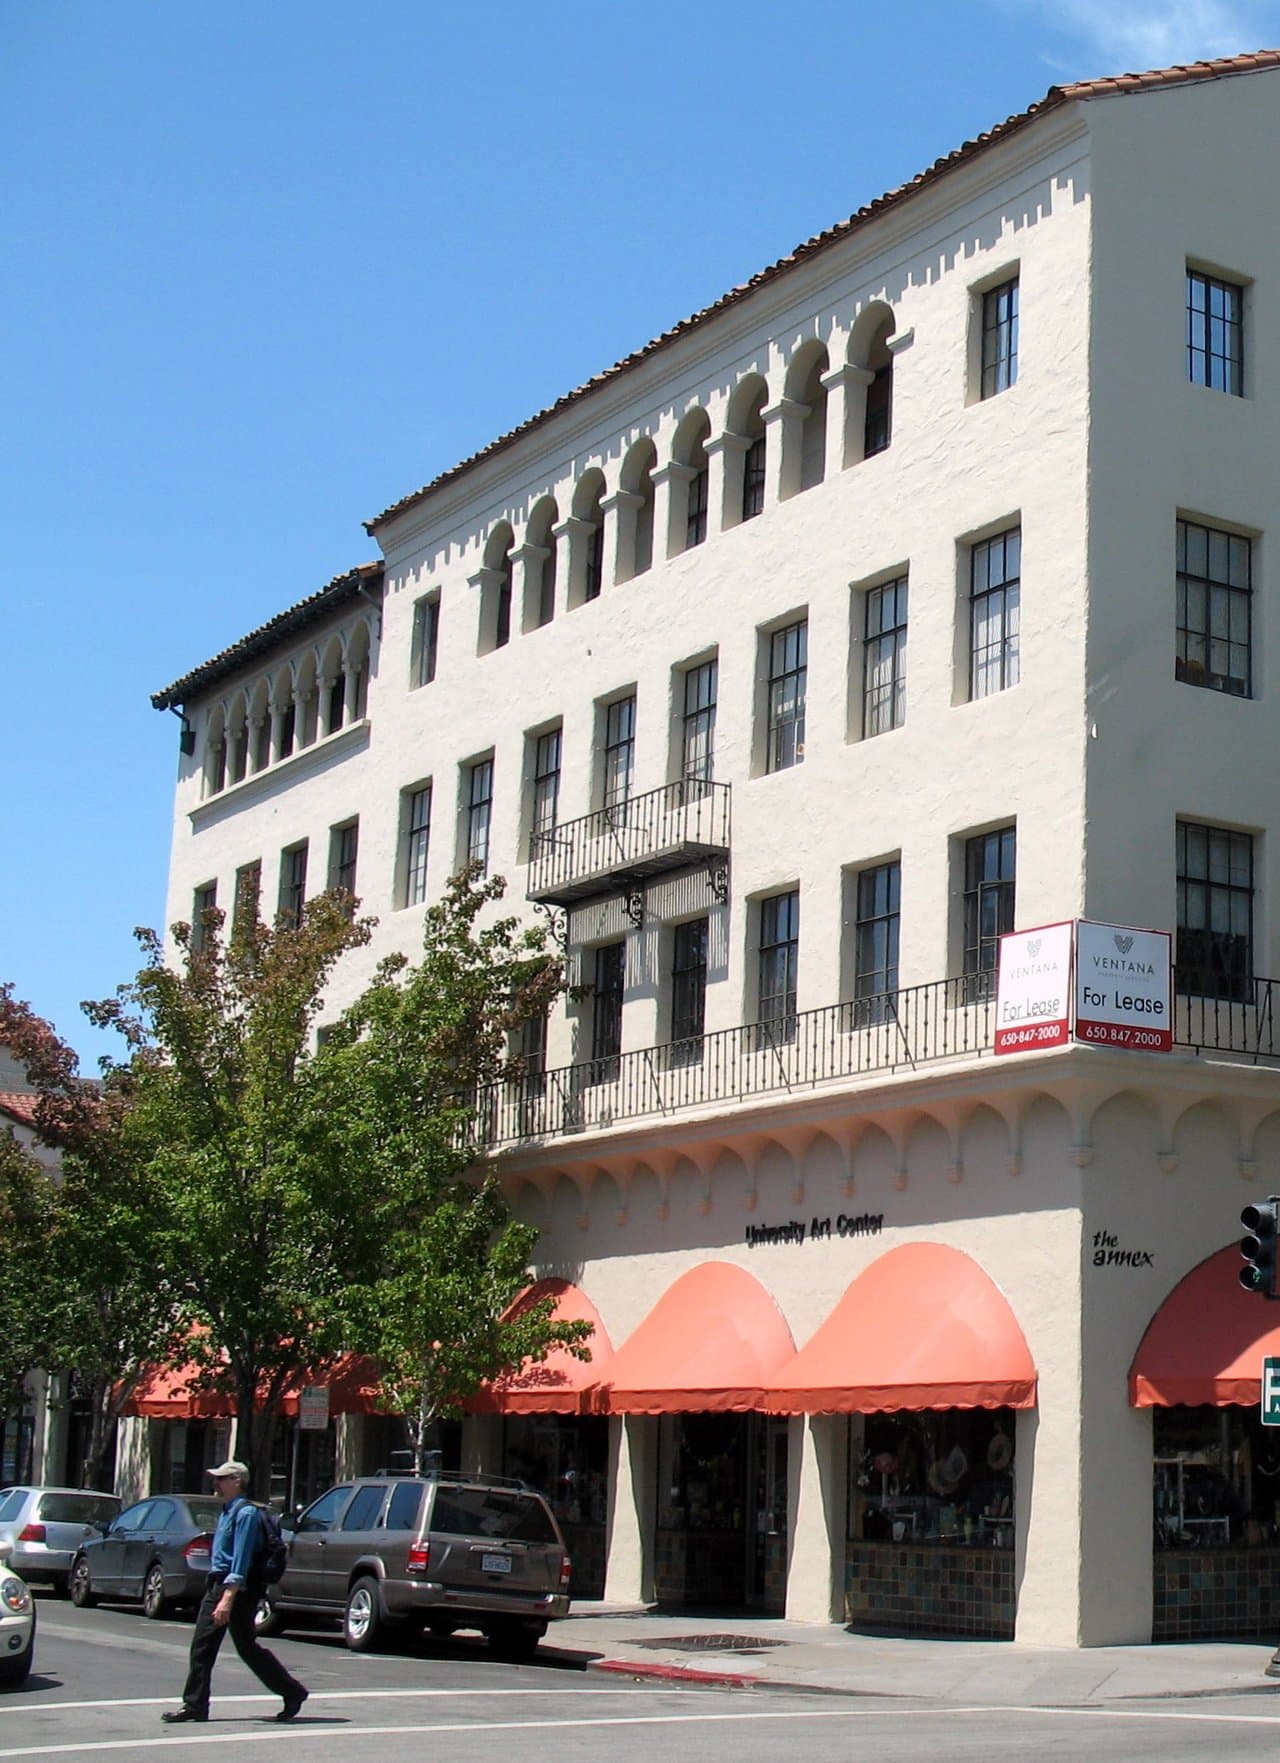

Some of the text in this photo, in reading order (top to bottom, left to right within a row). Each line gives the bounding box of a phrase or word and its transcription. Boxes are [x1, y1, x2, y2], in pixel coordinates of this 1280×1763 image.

[1009, 962, 1058, 979] VENTANA
[1092, 956, 1155, 975] VENTANA
[1003, 996, 1060, 1021] For Lease
[1083, 987, 1164, 1014] For Lease
[1086, 1026, 1161, 1045] 650.847.2000
[746, 1213, 884, 1249] University Art Center
[1093, 1230, 1119, 1247] the
[1093, 1249, 1154, 1268] annex
